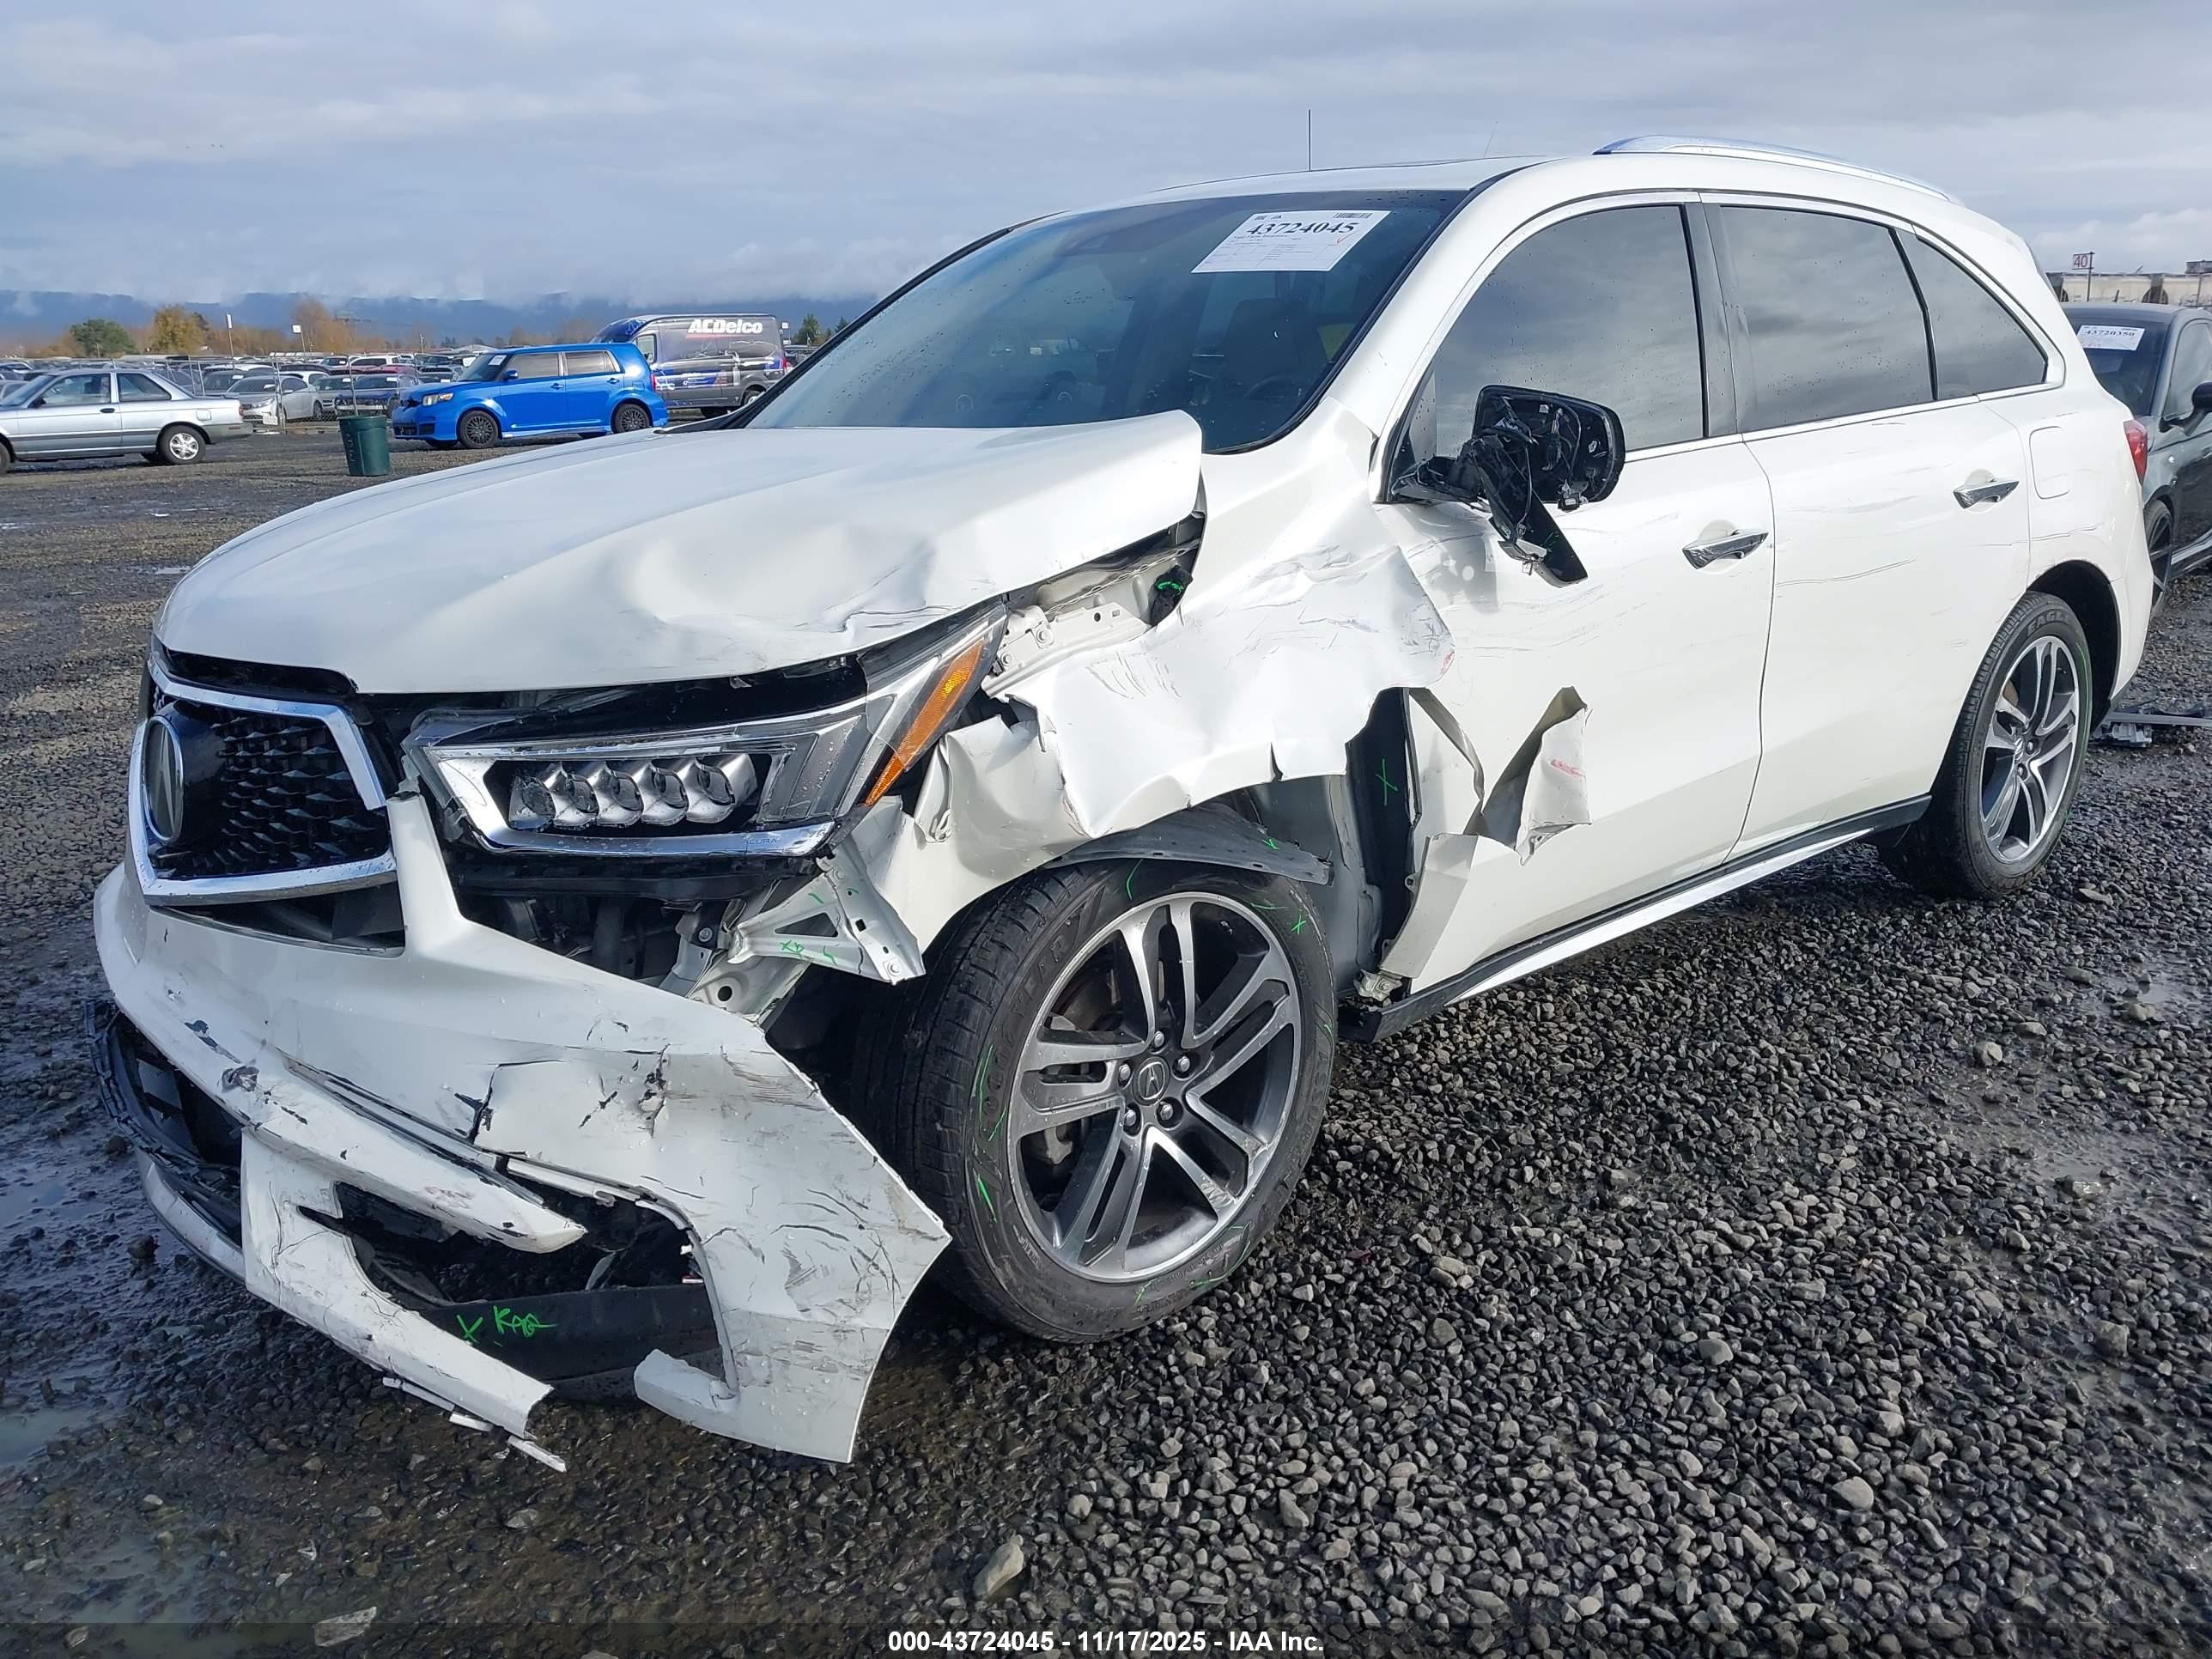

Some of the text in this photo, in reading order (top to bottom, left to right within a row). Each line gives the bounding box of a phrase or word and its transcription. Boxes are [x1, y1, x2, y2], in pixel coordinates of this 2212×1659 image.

[1248, 222, 1358, 234] 43724045
[2074, 255, 2087, 268] 40
[688, 319, 763, 334] ACDelco
